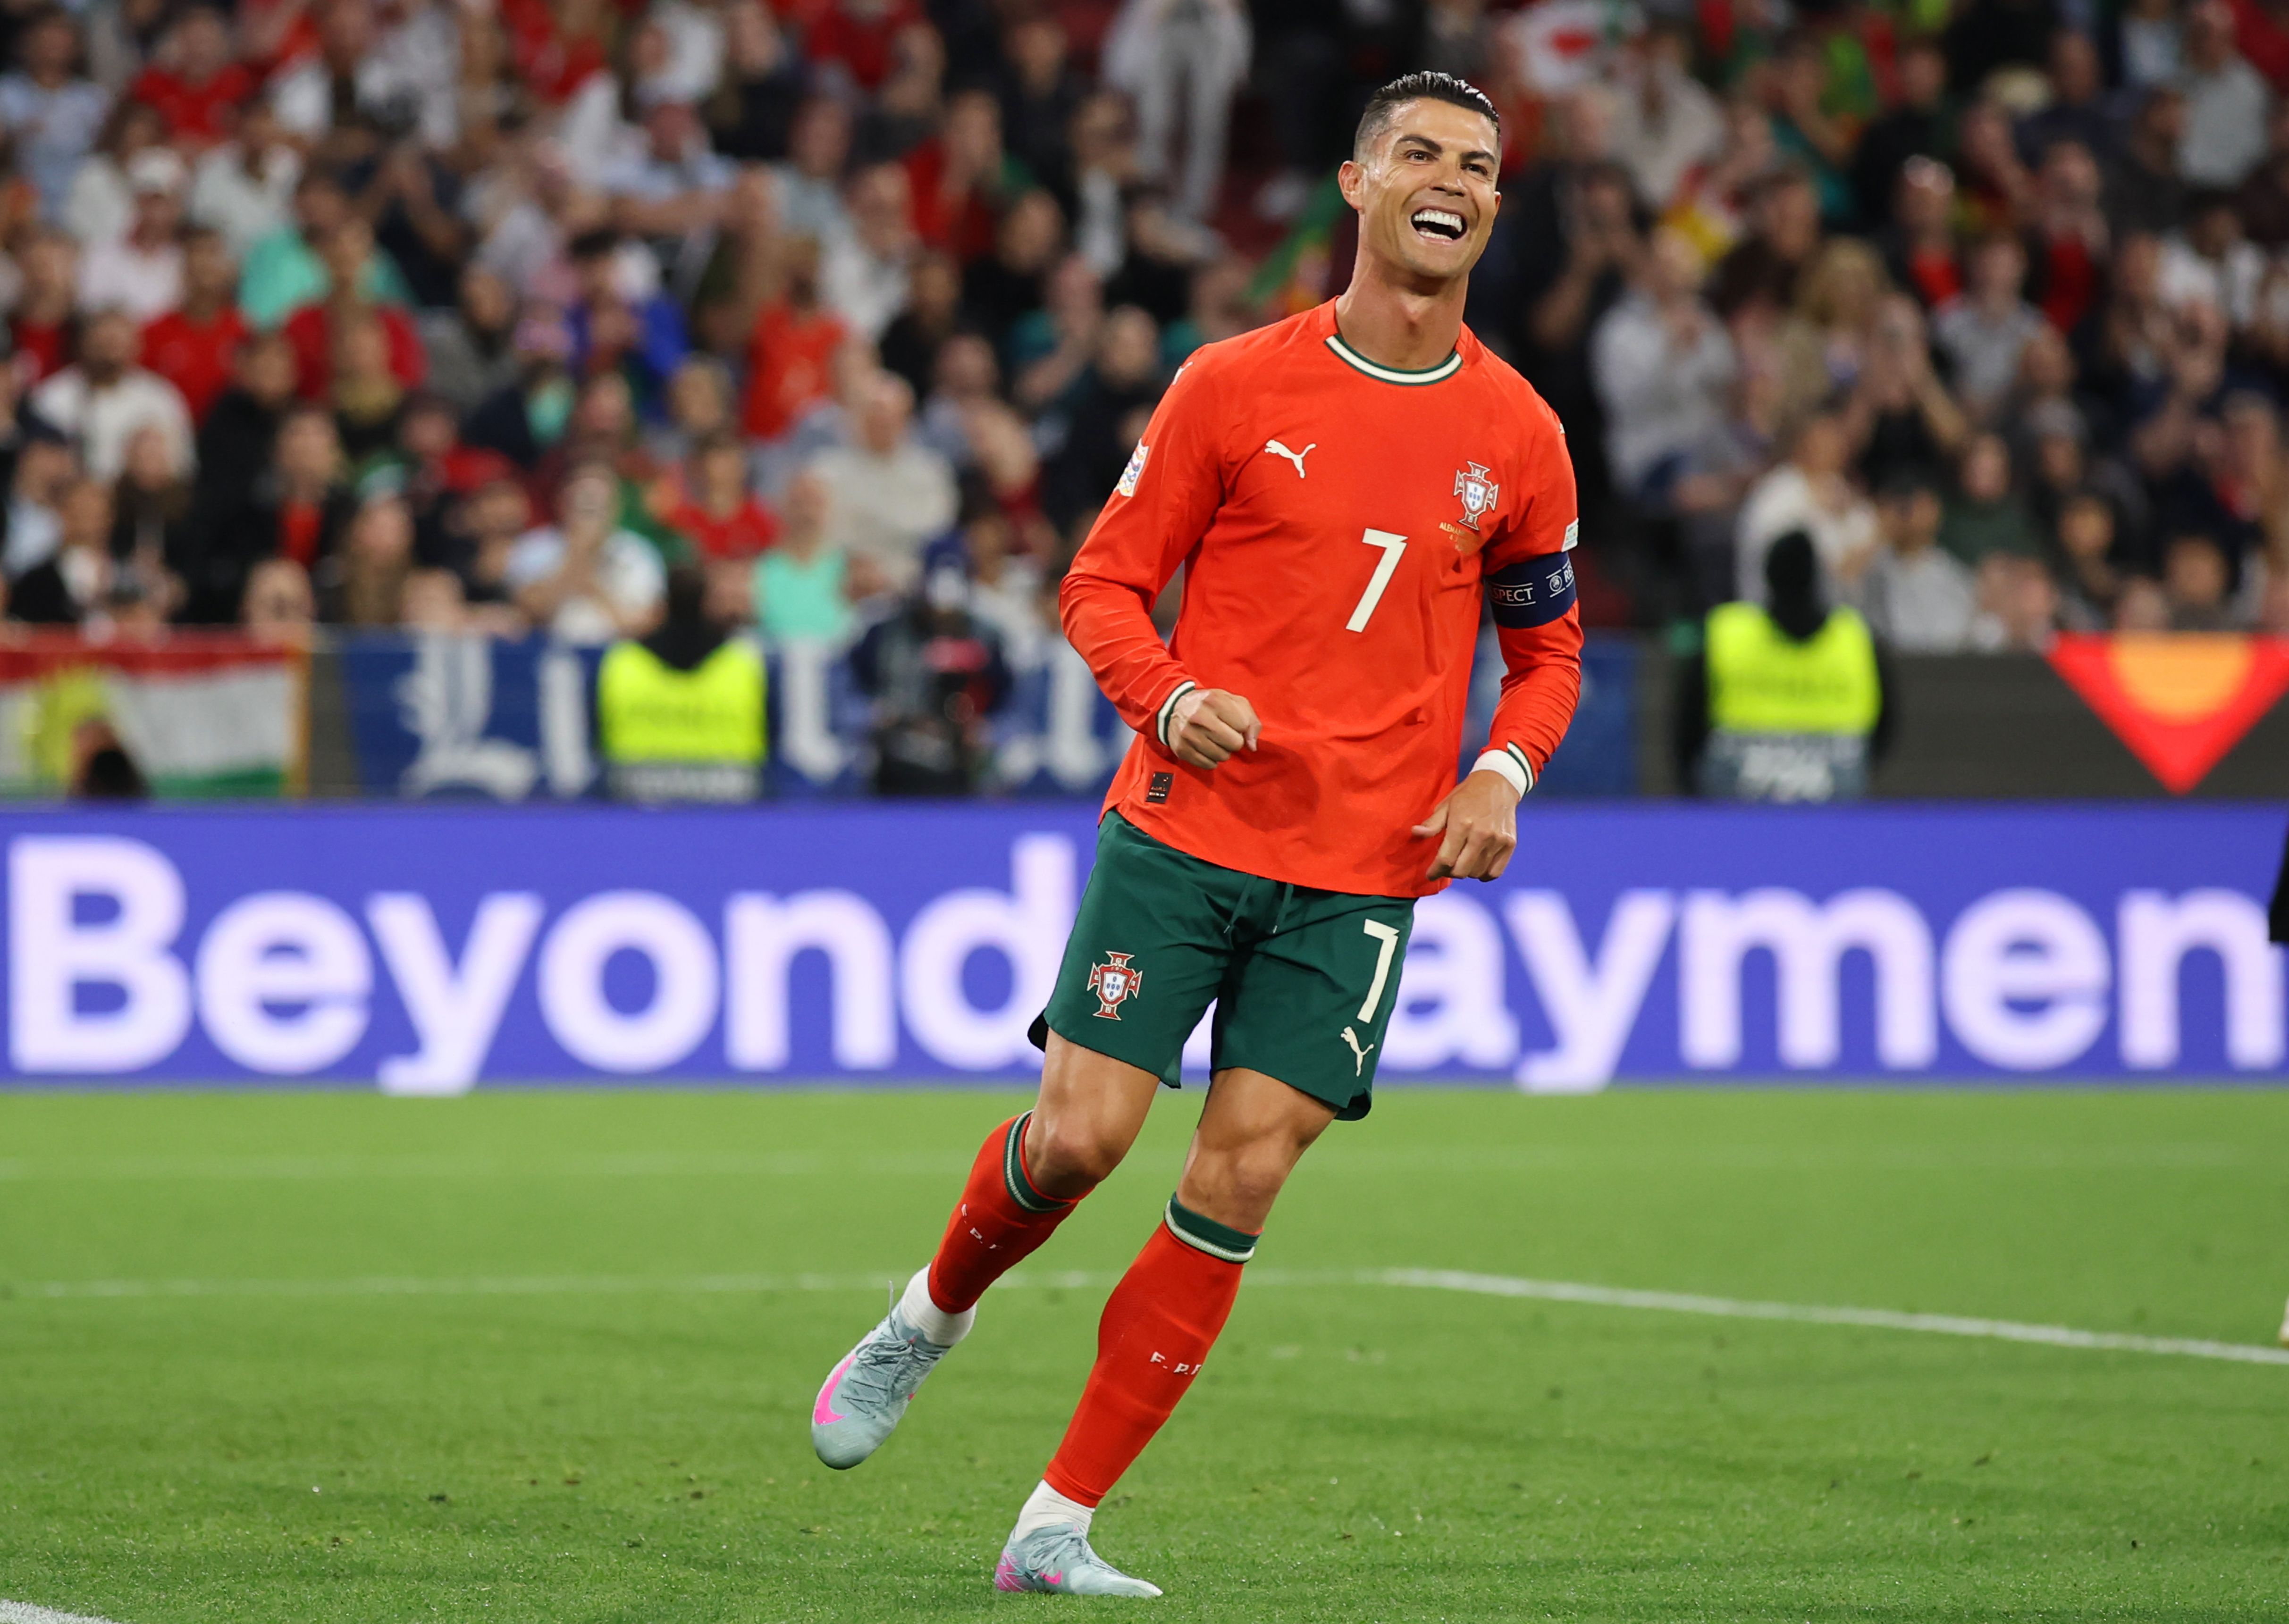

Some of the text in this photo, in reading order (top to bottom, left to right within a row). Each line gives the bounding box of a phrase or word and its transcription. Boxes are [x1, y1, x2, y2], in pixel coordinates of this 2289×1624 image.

[1345, 527, 1409, 633] 7
[1491, 587, 1534, 602] SPECT
[8, 832, 2286, 1096] Beyond aymen
[1357, 918, 1400, 1024] 7
